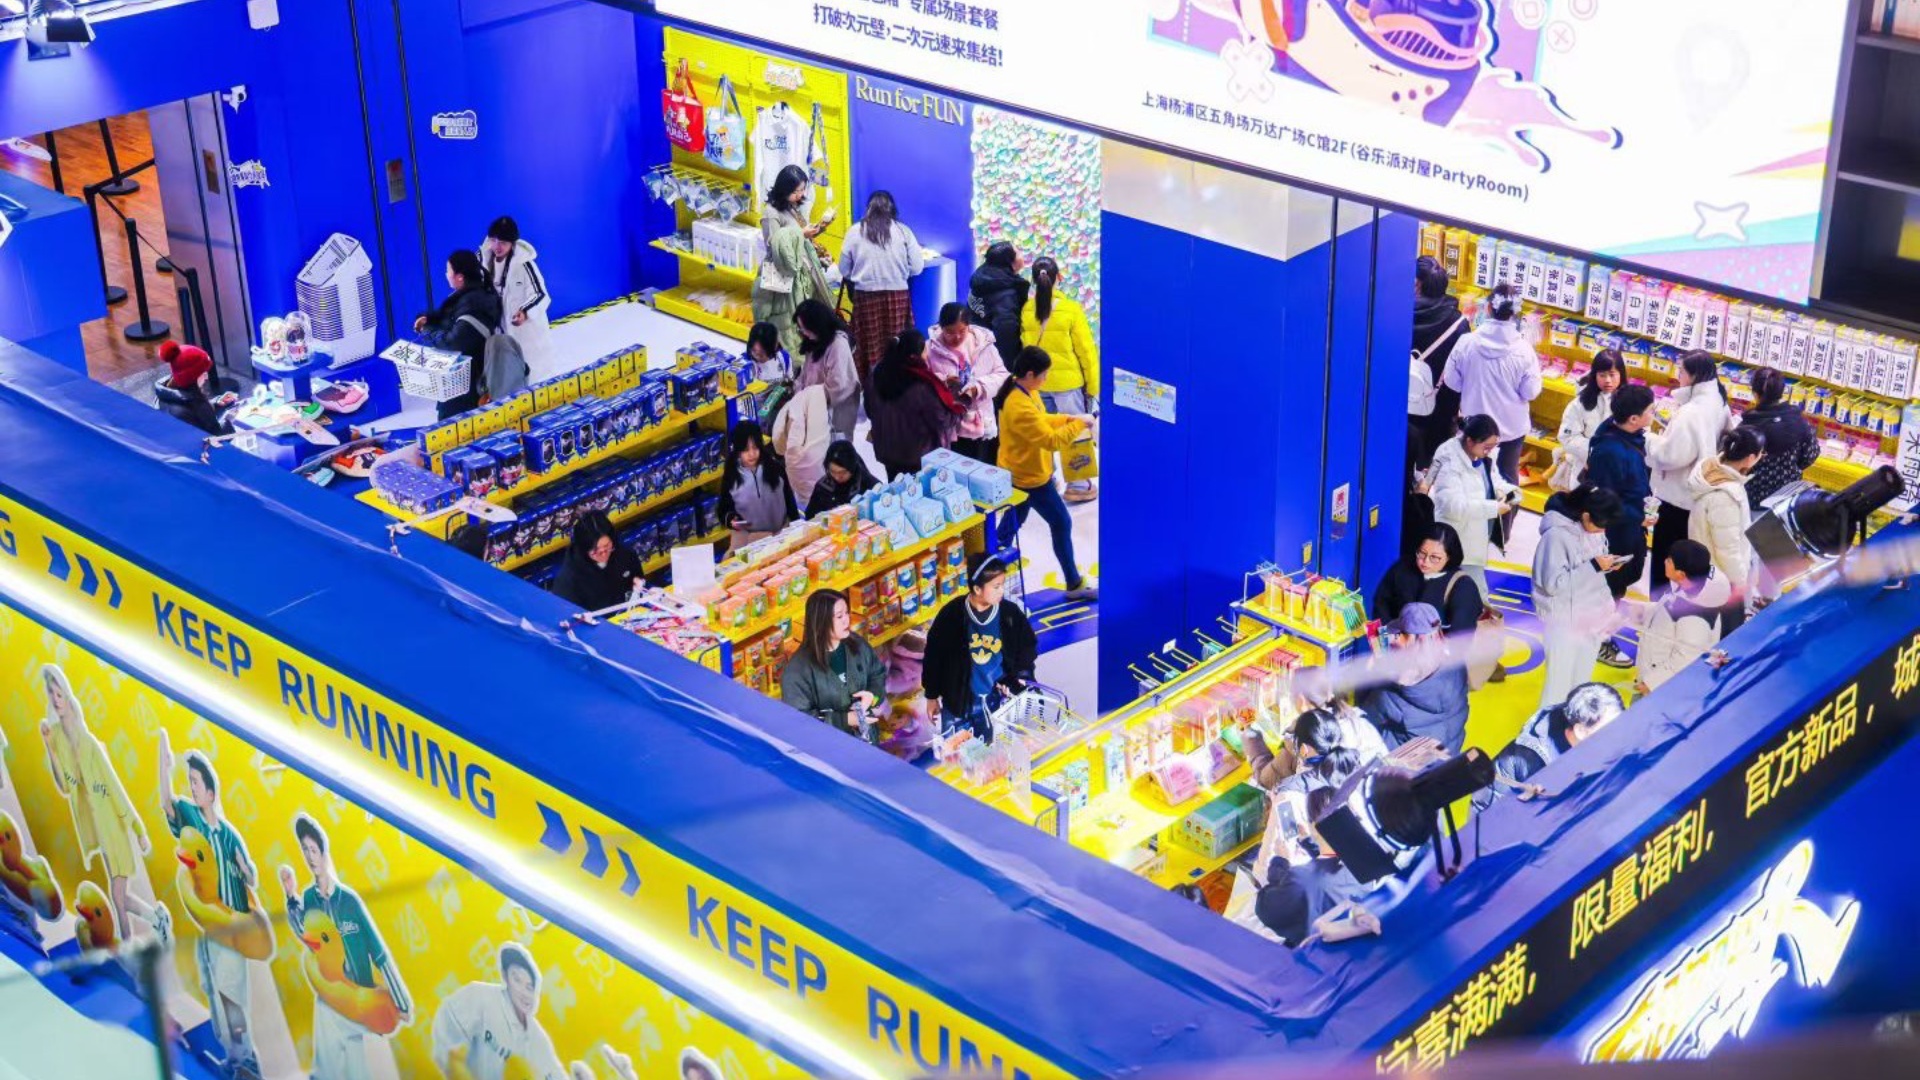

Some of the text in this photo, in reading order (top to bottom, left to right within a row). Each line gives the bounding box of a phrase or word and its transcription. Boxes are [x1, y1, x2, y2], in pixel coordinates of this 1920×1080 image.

[855, 75, 964, 126] Run for FUN
[1528, 265, 1541, 298] 白鹿
[1563, 273, 1577, 308] 周深
[1588, 282, 1603, 317] 范丞丞
[1608, 288, 1623, 323] 周深
[1626, 296, 1642, 330] 白鹿
[1660, 304, 1681, 341] 范丞丞
[152, 591, 251, 677] KEEP
[277, 658, 497, 820] RUNNING
[686, 884, 828, 1000] KEEP
[867, 985, 1031, 1080] RUN
